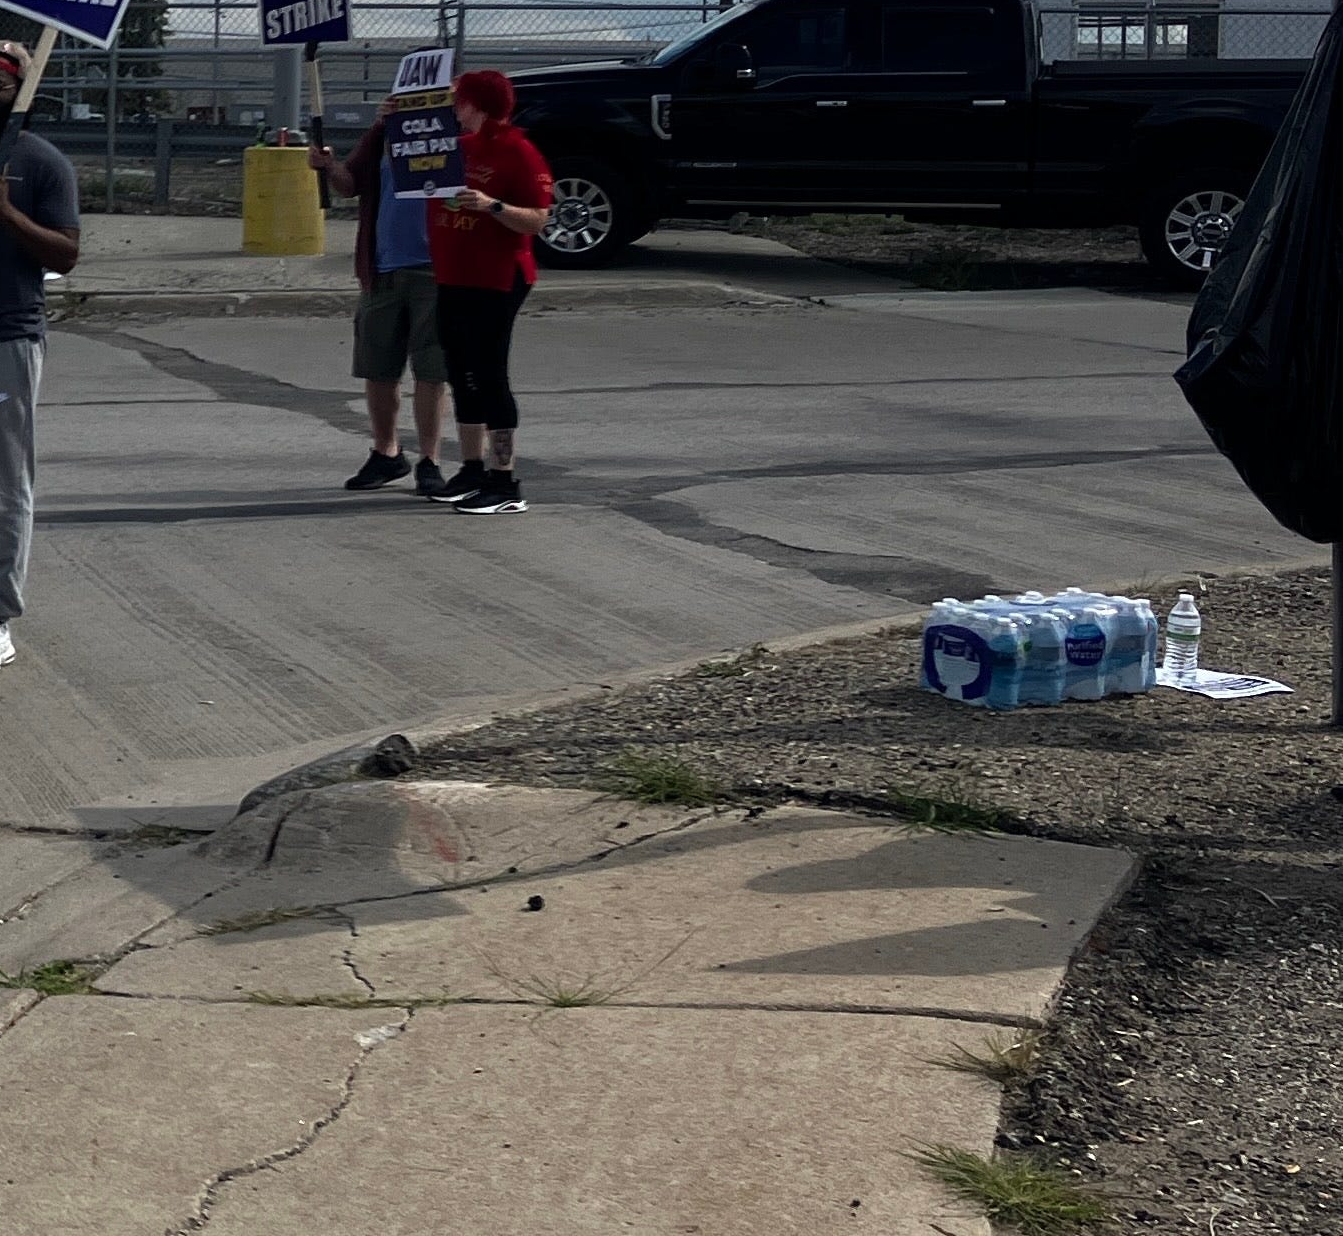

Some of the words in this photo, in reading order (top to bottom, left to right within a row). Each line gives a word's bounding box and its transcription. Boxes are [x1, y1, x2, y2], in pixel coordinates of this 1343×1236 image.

[402, 117, 444, 135] COLA
[391, 139, 428, 158] FAIR
[429, 137, 458, 153] PAY
[1066, 640, 1106, 652] Purified
[1069, 650, 1103, 660] Water
